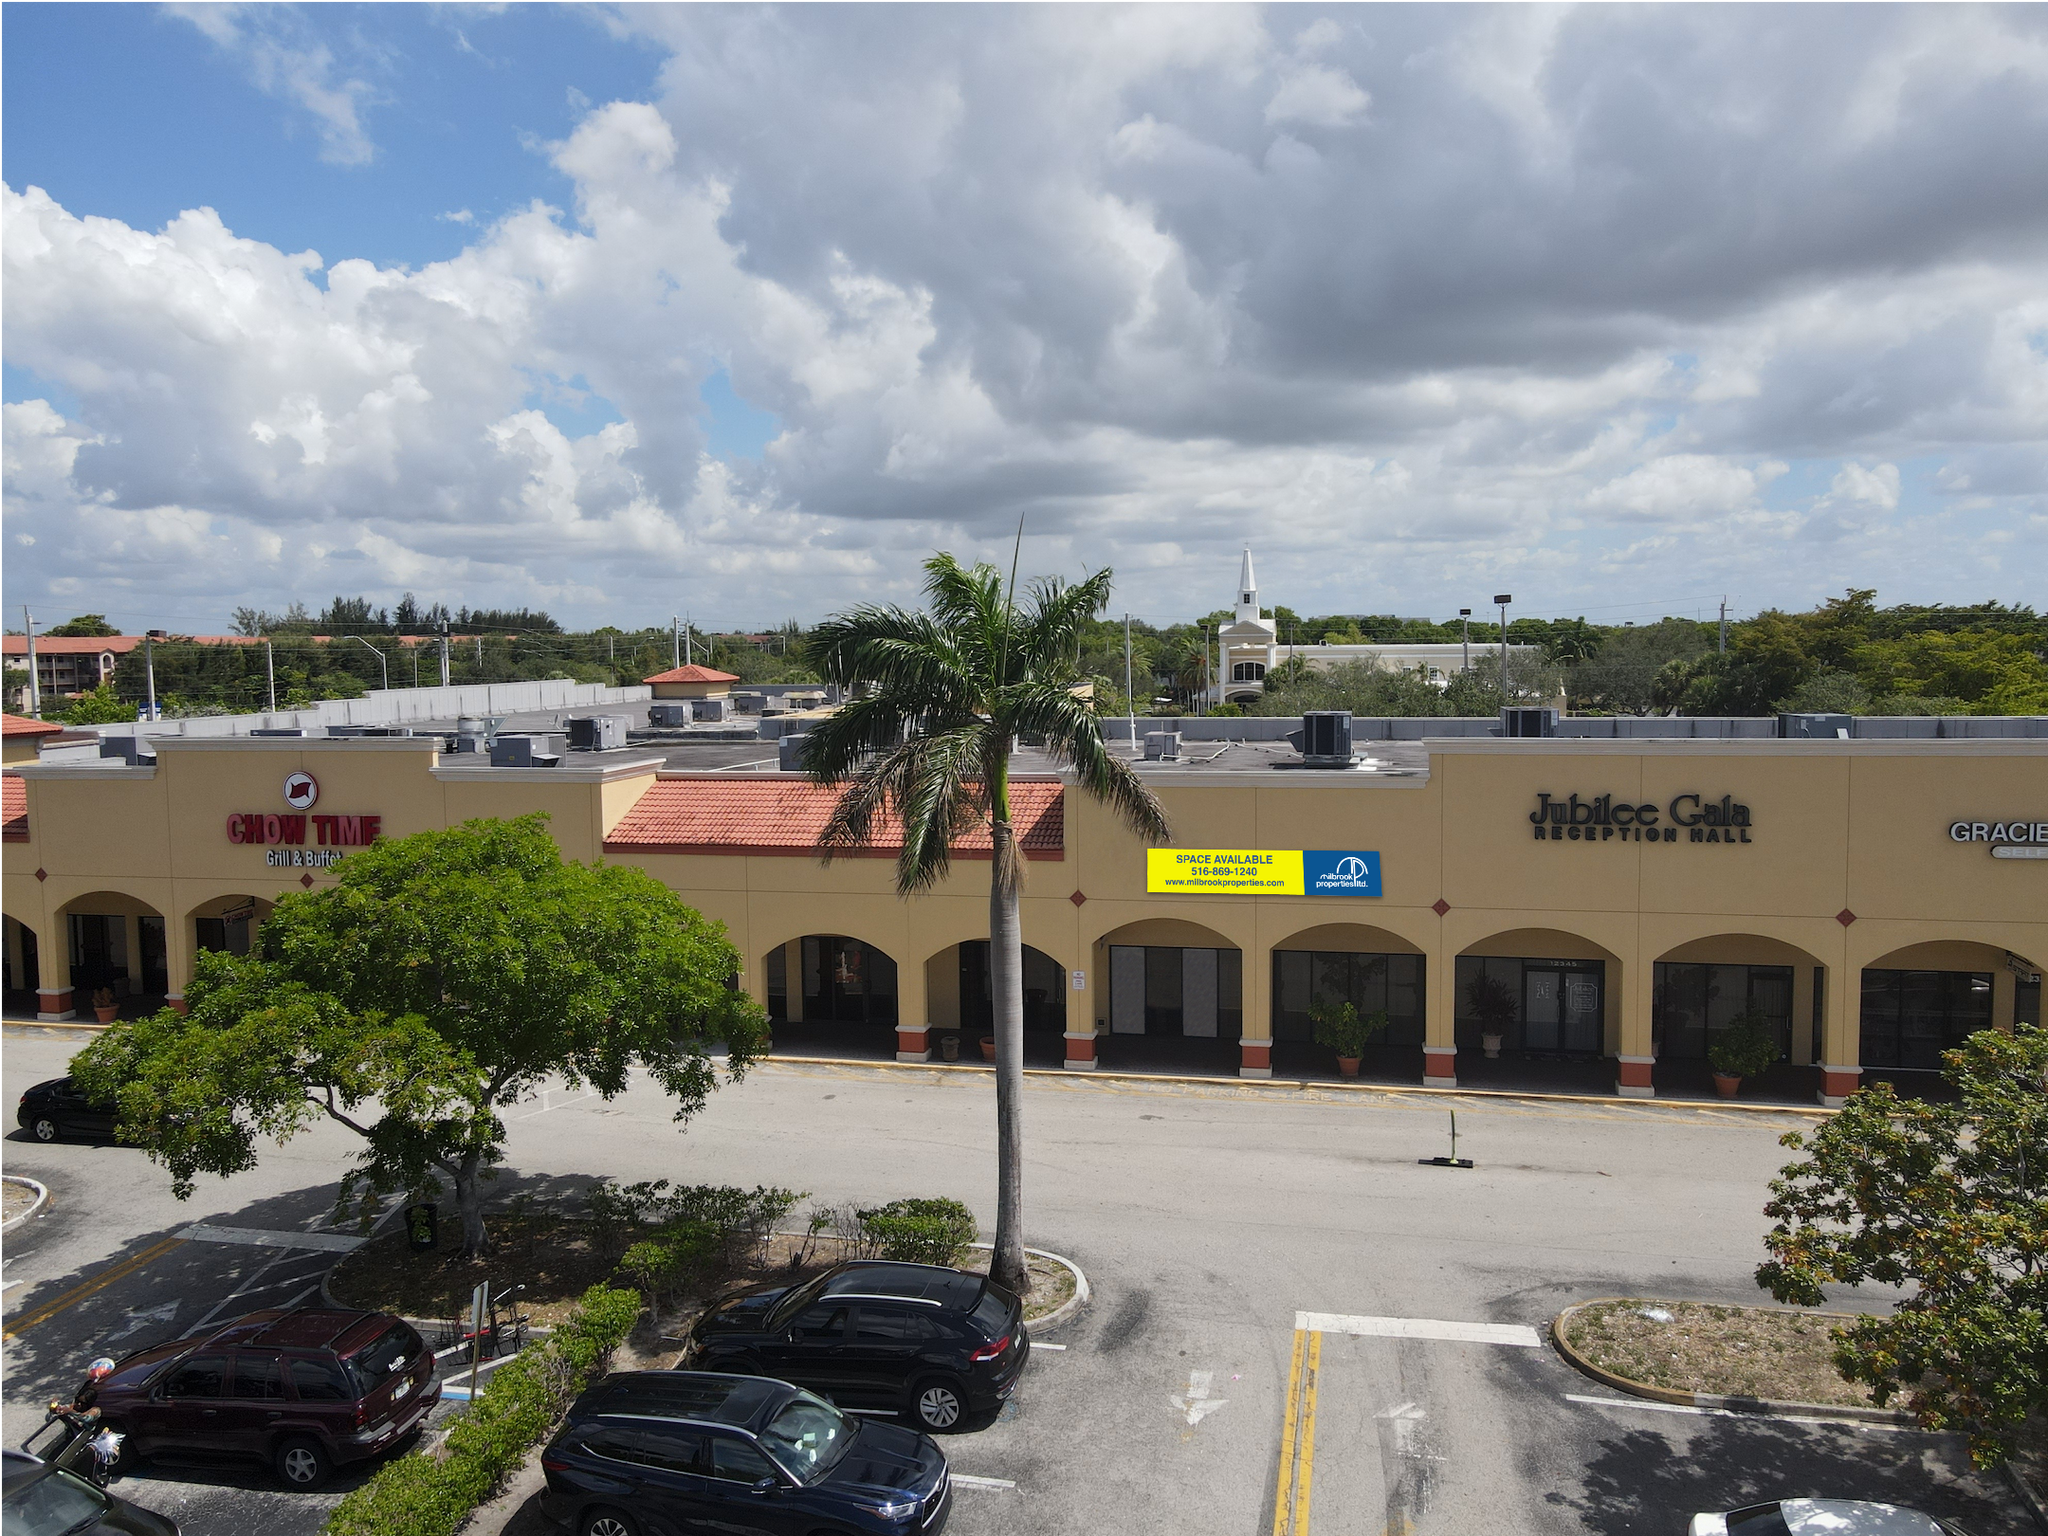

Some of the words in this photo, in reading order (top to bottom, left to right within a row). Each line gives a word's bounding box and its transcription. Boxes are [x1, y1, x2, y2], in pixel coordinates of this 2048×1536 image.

[1529, 793, 1660, 825] Jubilee
[1669, 794, 1752, 827] Gala
[226, 813, 307, 845] CHOW
[311, 814, 381, 846] TIME
[1534, 826, 1677, 842] RECEPTION
[1690, 828, 1752, 843] HALL
[1949, 821, 2048, 843] GRACIE
[266, 850, 291, 867] Grill
[293, 850, 303, 867] &
[1176, 854, 1212, 864] SPACE
[1213, 855, 1273, 864] AVAILABLE
[1999, 848, 2047, 857] SELF
[1191, 867, 1257, 876] 516-869-1240
[1165, 878, 1285, 888] www.milbrookproperties.com
[1316, 880, 1353, 888] properties
[1148, 1084, 1174, 1093] NO
[1183, 1085, 1260, 1098] PARKING
[1290, 1091, 1333, 1102] FIRE
[1345, 1093, 1395, 1104] LANE
